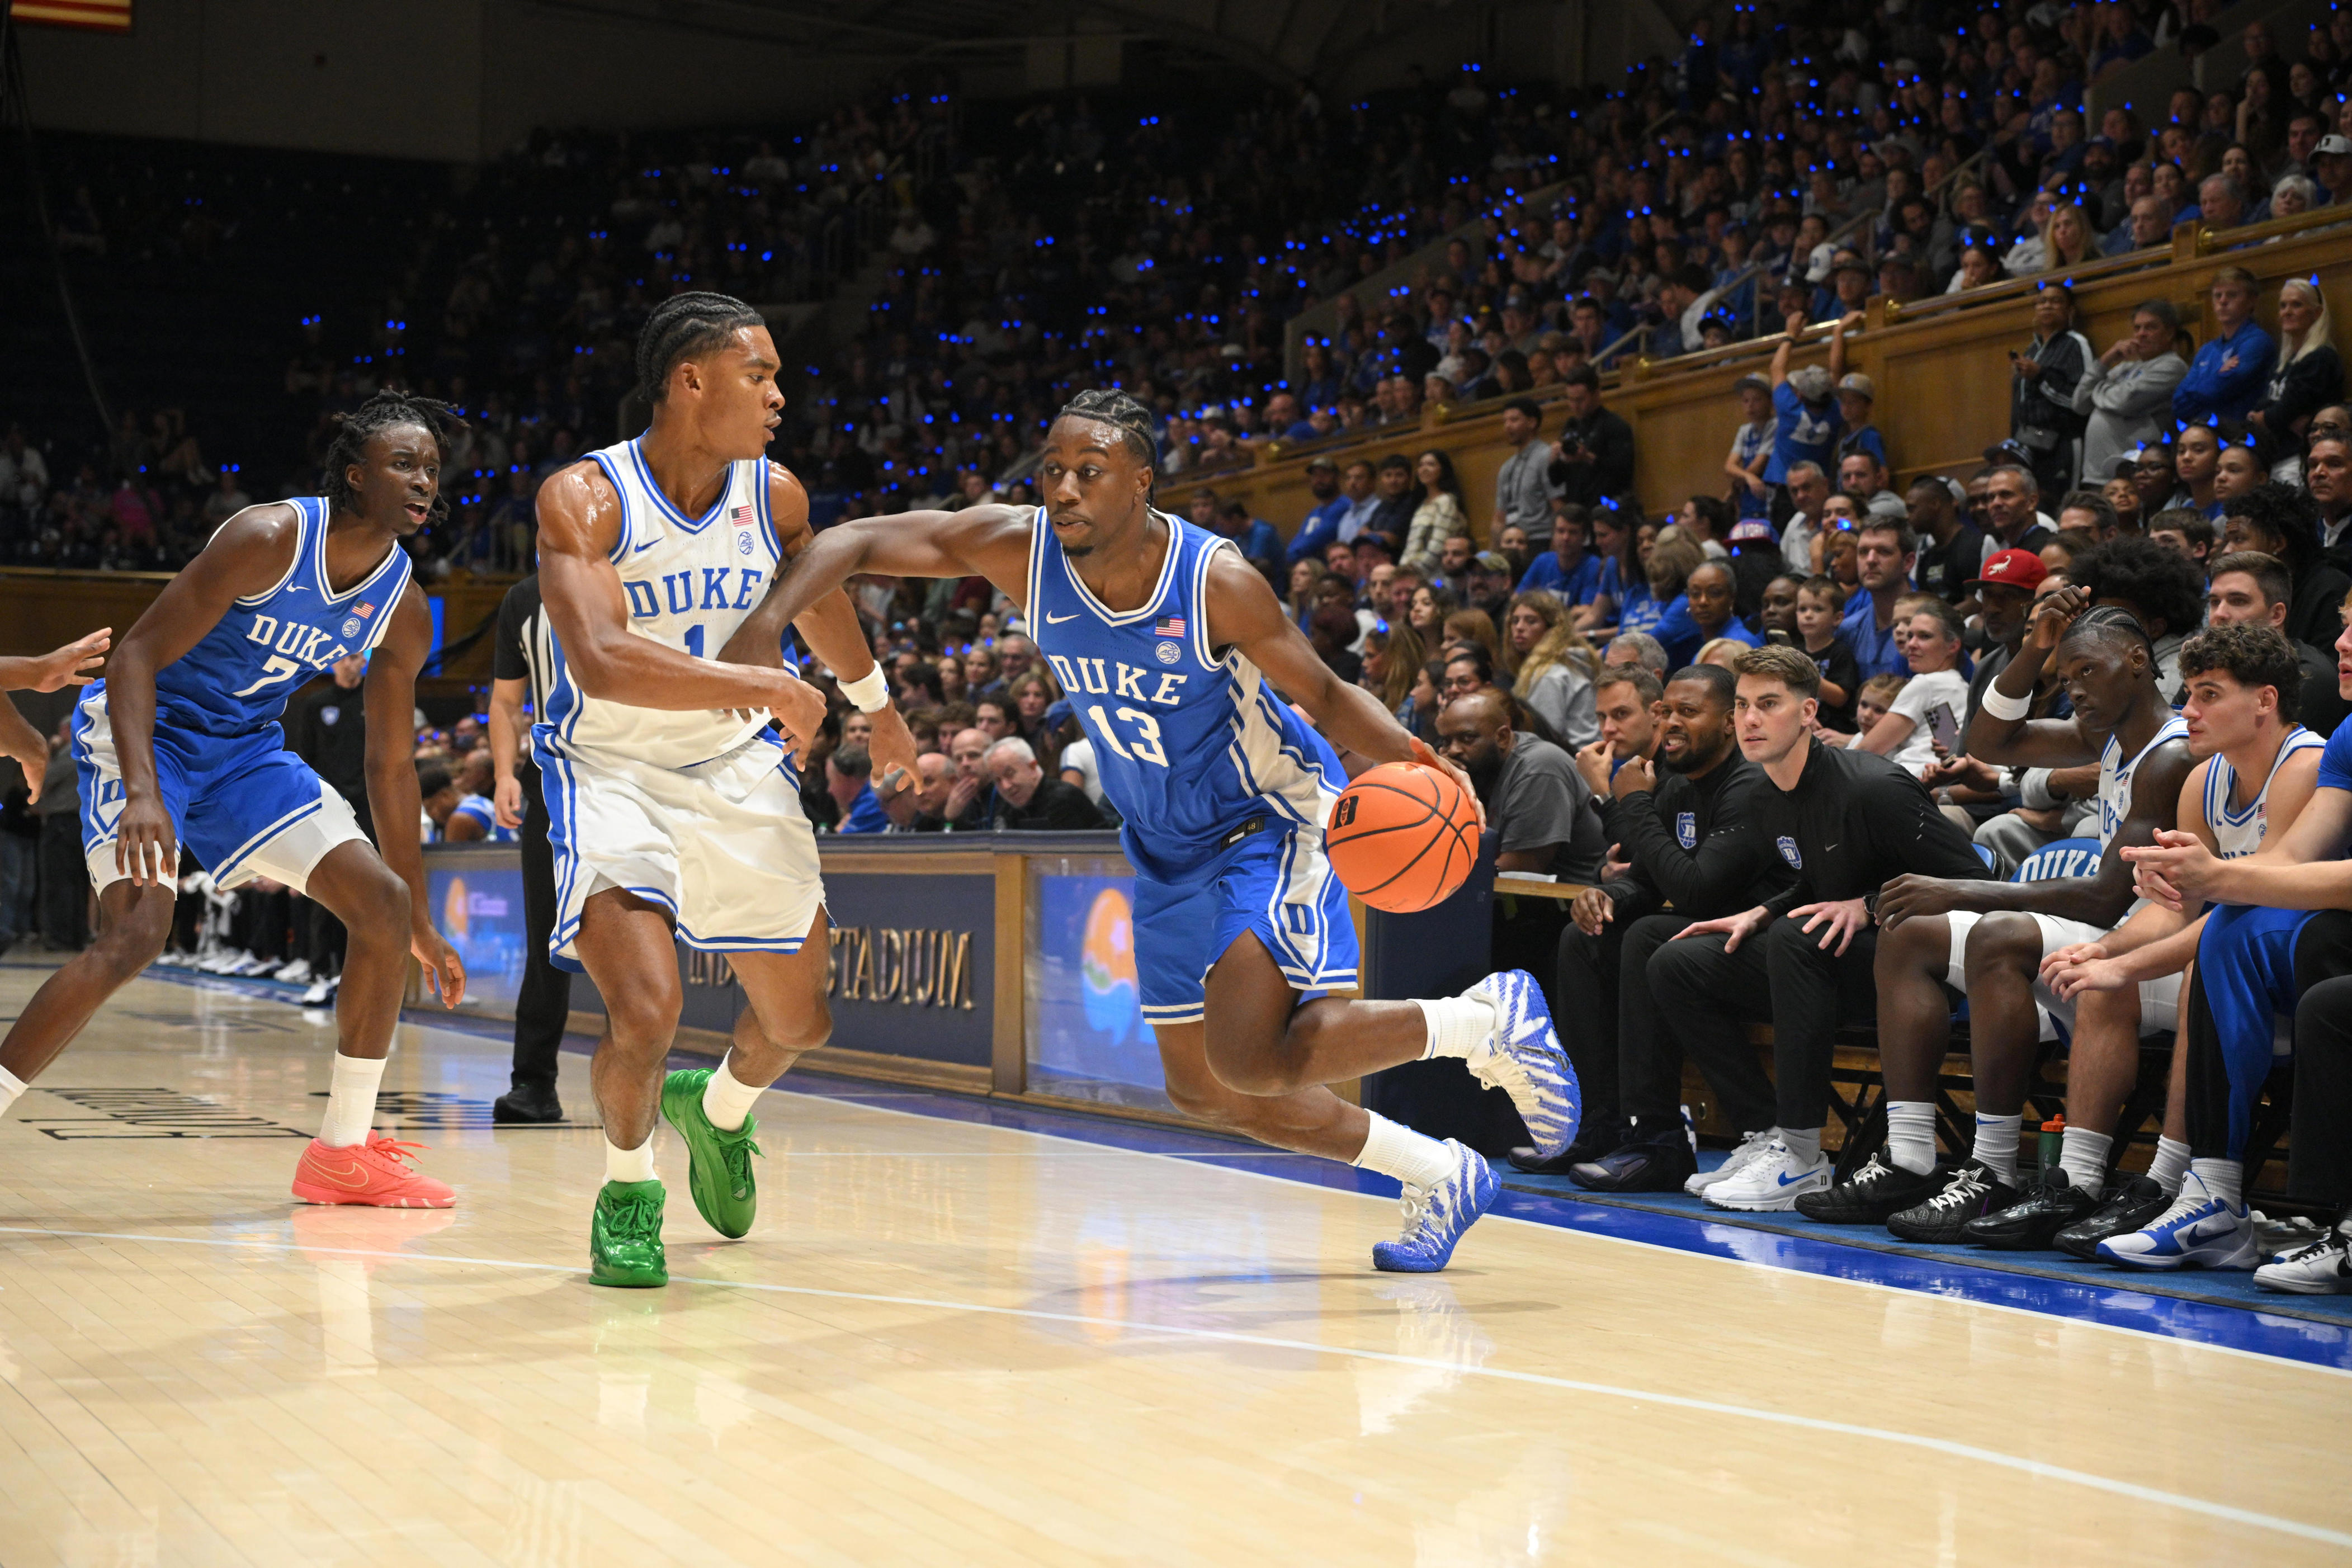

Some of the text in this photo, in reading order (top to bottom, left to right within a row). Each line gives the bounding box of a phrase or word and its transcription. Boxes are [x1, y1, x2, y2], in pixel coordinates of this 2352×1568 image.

[624, 567, 762, 617] DUKE
[246, 613, 348, 670] DUKE
[684, 625, 704, 659] 1
[232, 654, 300, 697] 7
[1048, 655, 1188, 705] DUKE
[1088, 705, 1169, 767] 13
[1248, 823, 1256, 831] 48
[1284, 903, 1315, 935] D
